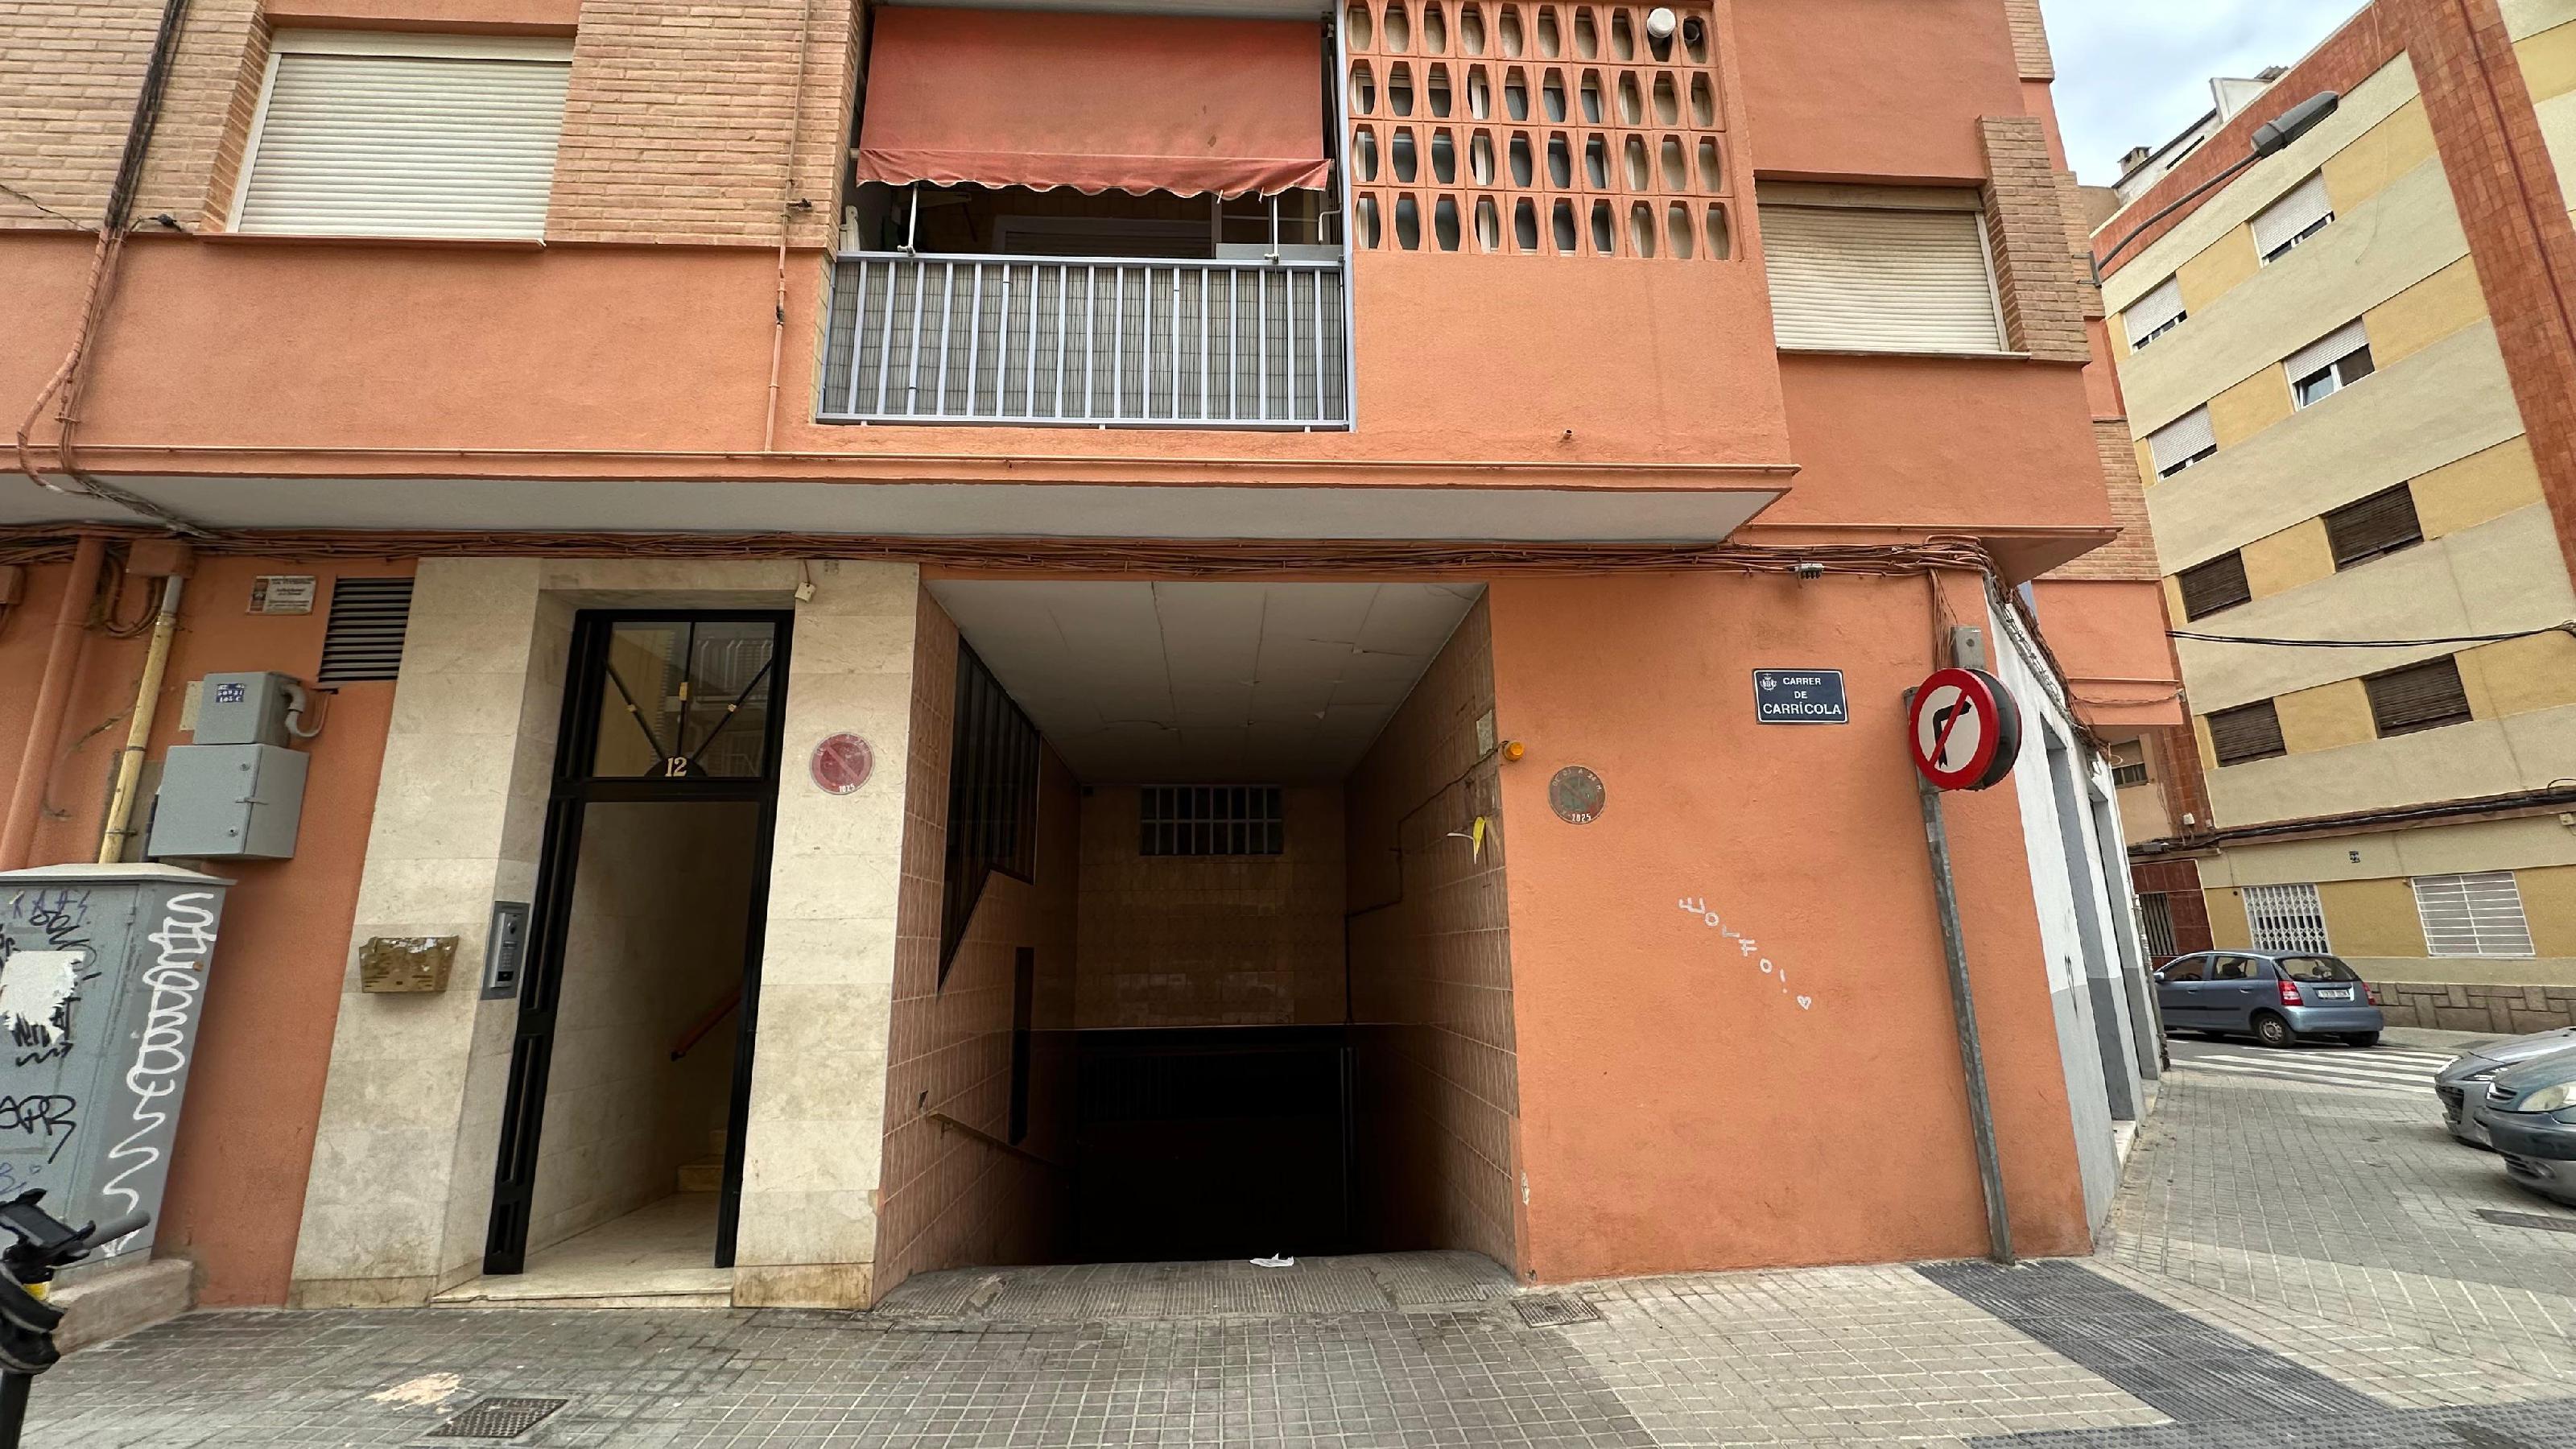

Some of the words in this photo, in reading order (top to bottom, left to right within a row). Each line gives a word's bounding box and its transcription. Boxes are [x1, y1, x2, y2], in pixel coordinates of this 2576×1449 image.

[1782, 677, 1822, 686] CARRER
[1794, 691, 1808, 699] DE
[1763, 701, 1843, 715] CARRÍCOLA
[665, 757, 687, 777] 12
